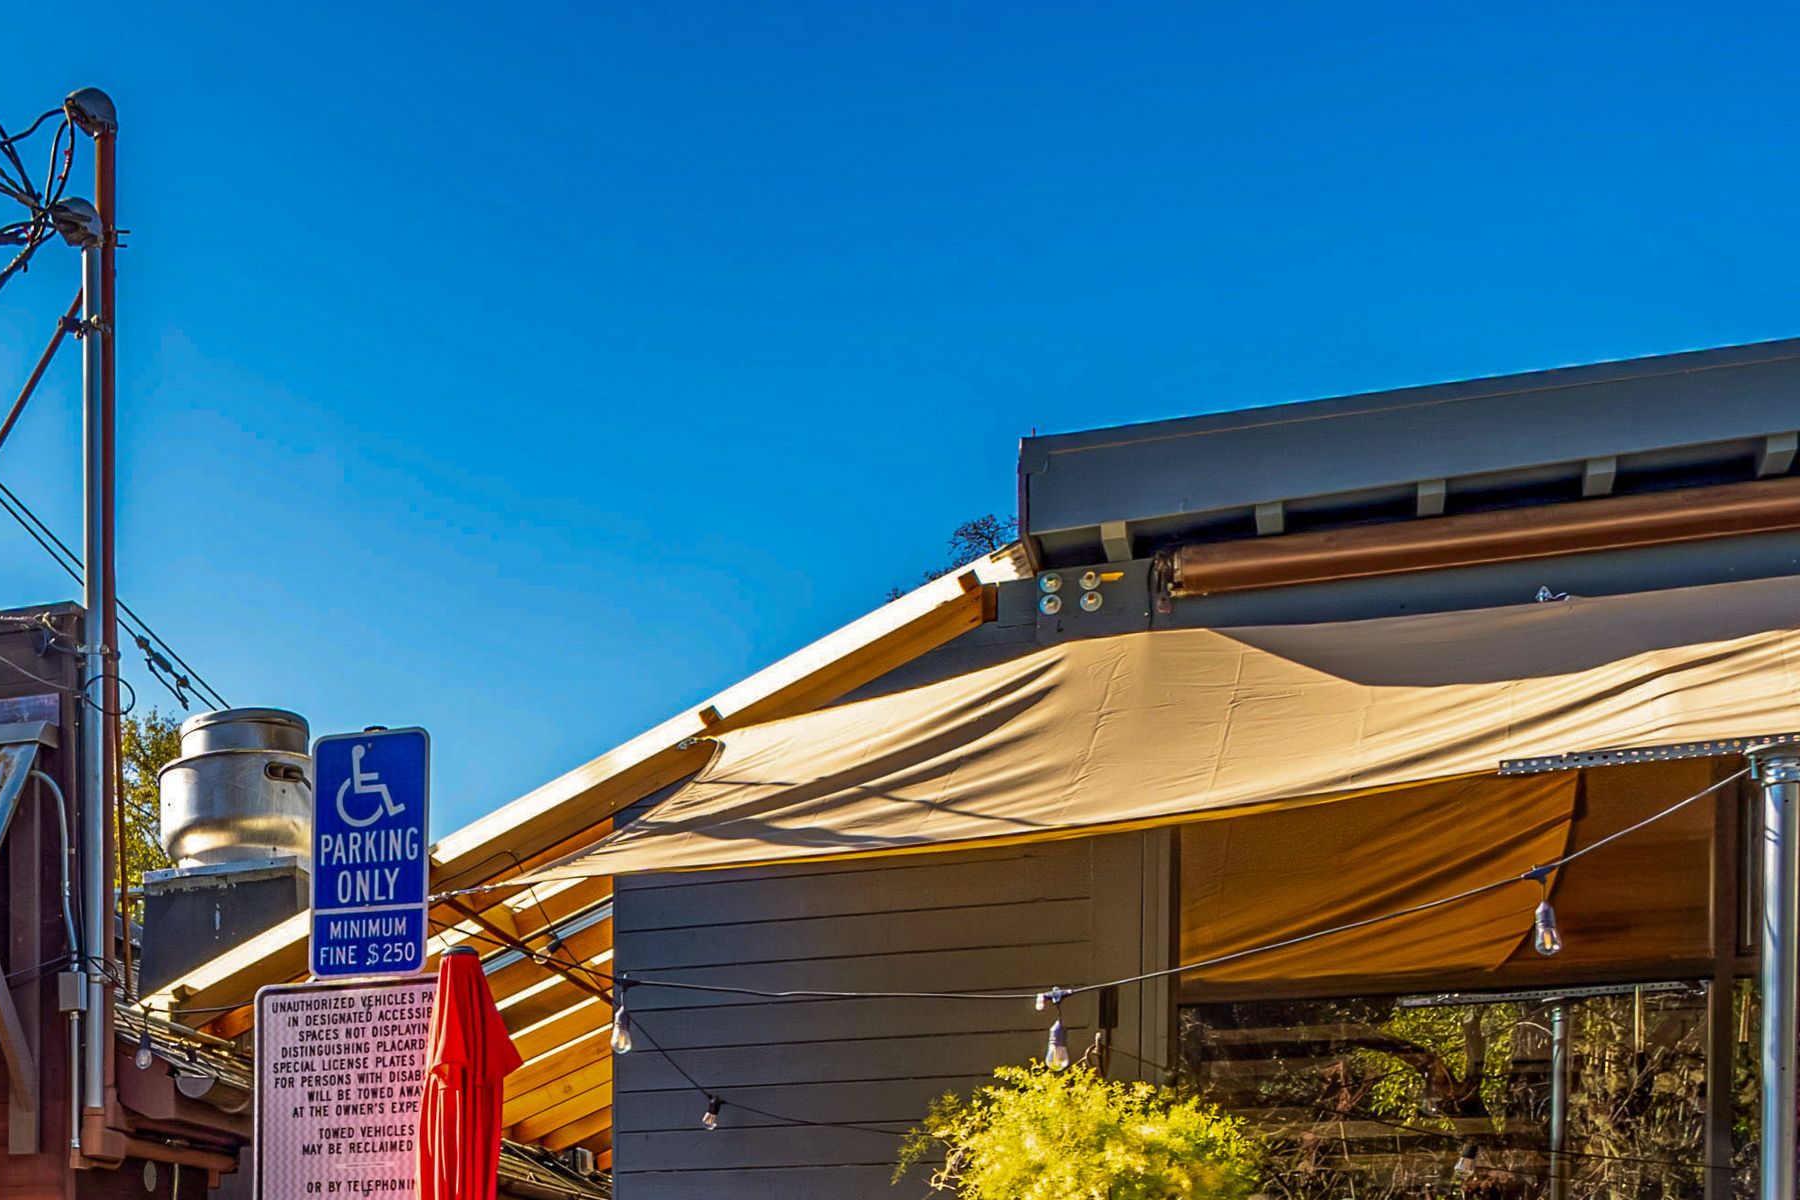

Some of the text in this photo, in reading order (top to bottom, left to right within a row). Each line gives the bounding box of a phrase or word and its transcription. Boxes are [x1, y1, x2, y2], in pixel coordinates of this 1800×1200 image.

[320, 826, 419, 866] PARKING
[337, 867, 400, 904] ONLY
[329, 916, 407, 940] MINIMUM
[320, 941, 415, 966] FINE $250
[271, 991, 437, 1013] UNAUTHORIZED VEHICLES PA
[287, 1006, 434, 1028] IN DESIGNATED ACCESSIB
[298, 1022, 429, 1042] SPACES NOT DISPLAYIN
[281, 1038, 429, 1059] DISTINGUISHING PLACARD
[272, 1060, 317, 1074] SPECIAL
[321, 1057, 369, 1071] LICENSE
[375, 1054, 416, 1068] PLATES
[274, 1076, 295, 1089] FOR
[300, 1073, 351, 1088] PERSONS
[357, 1072, 382, 1084] WITH
[307, 1090, 332, 1102] WILL
[337, 1089, 351, 1101] BE
[357, 1086, 394, 1100] TOWED
[292, 1101, 419, 1118] AT THE OWNER'S EXPE
[318, 1124, 415, 1140] TOWED VEHICLES
[302, 1139, 413, 1156] MAY BE RECLAIMED
[306, 1181, 322, 1193] OR
[328, 1181, 342, 1193] BY
